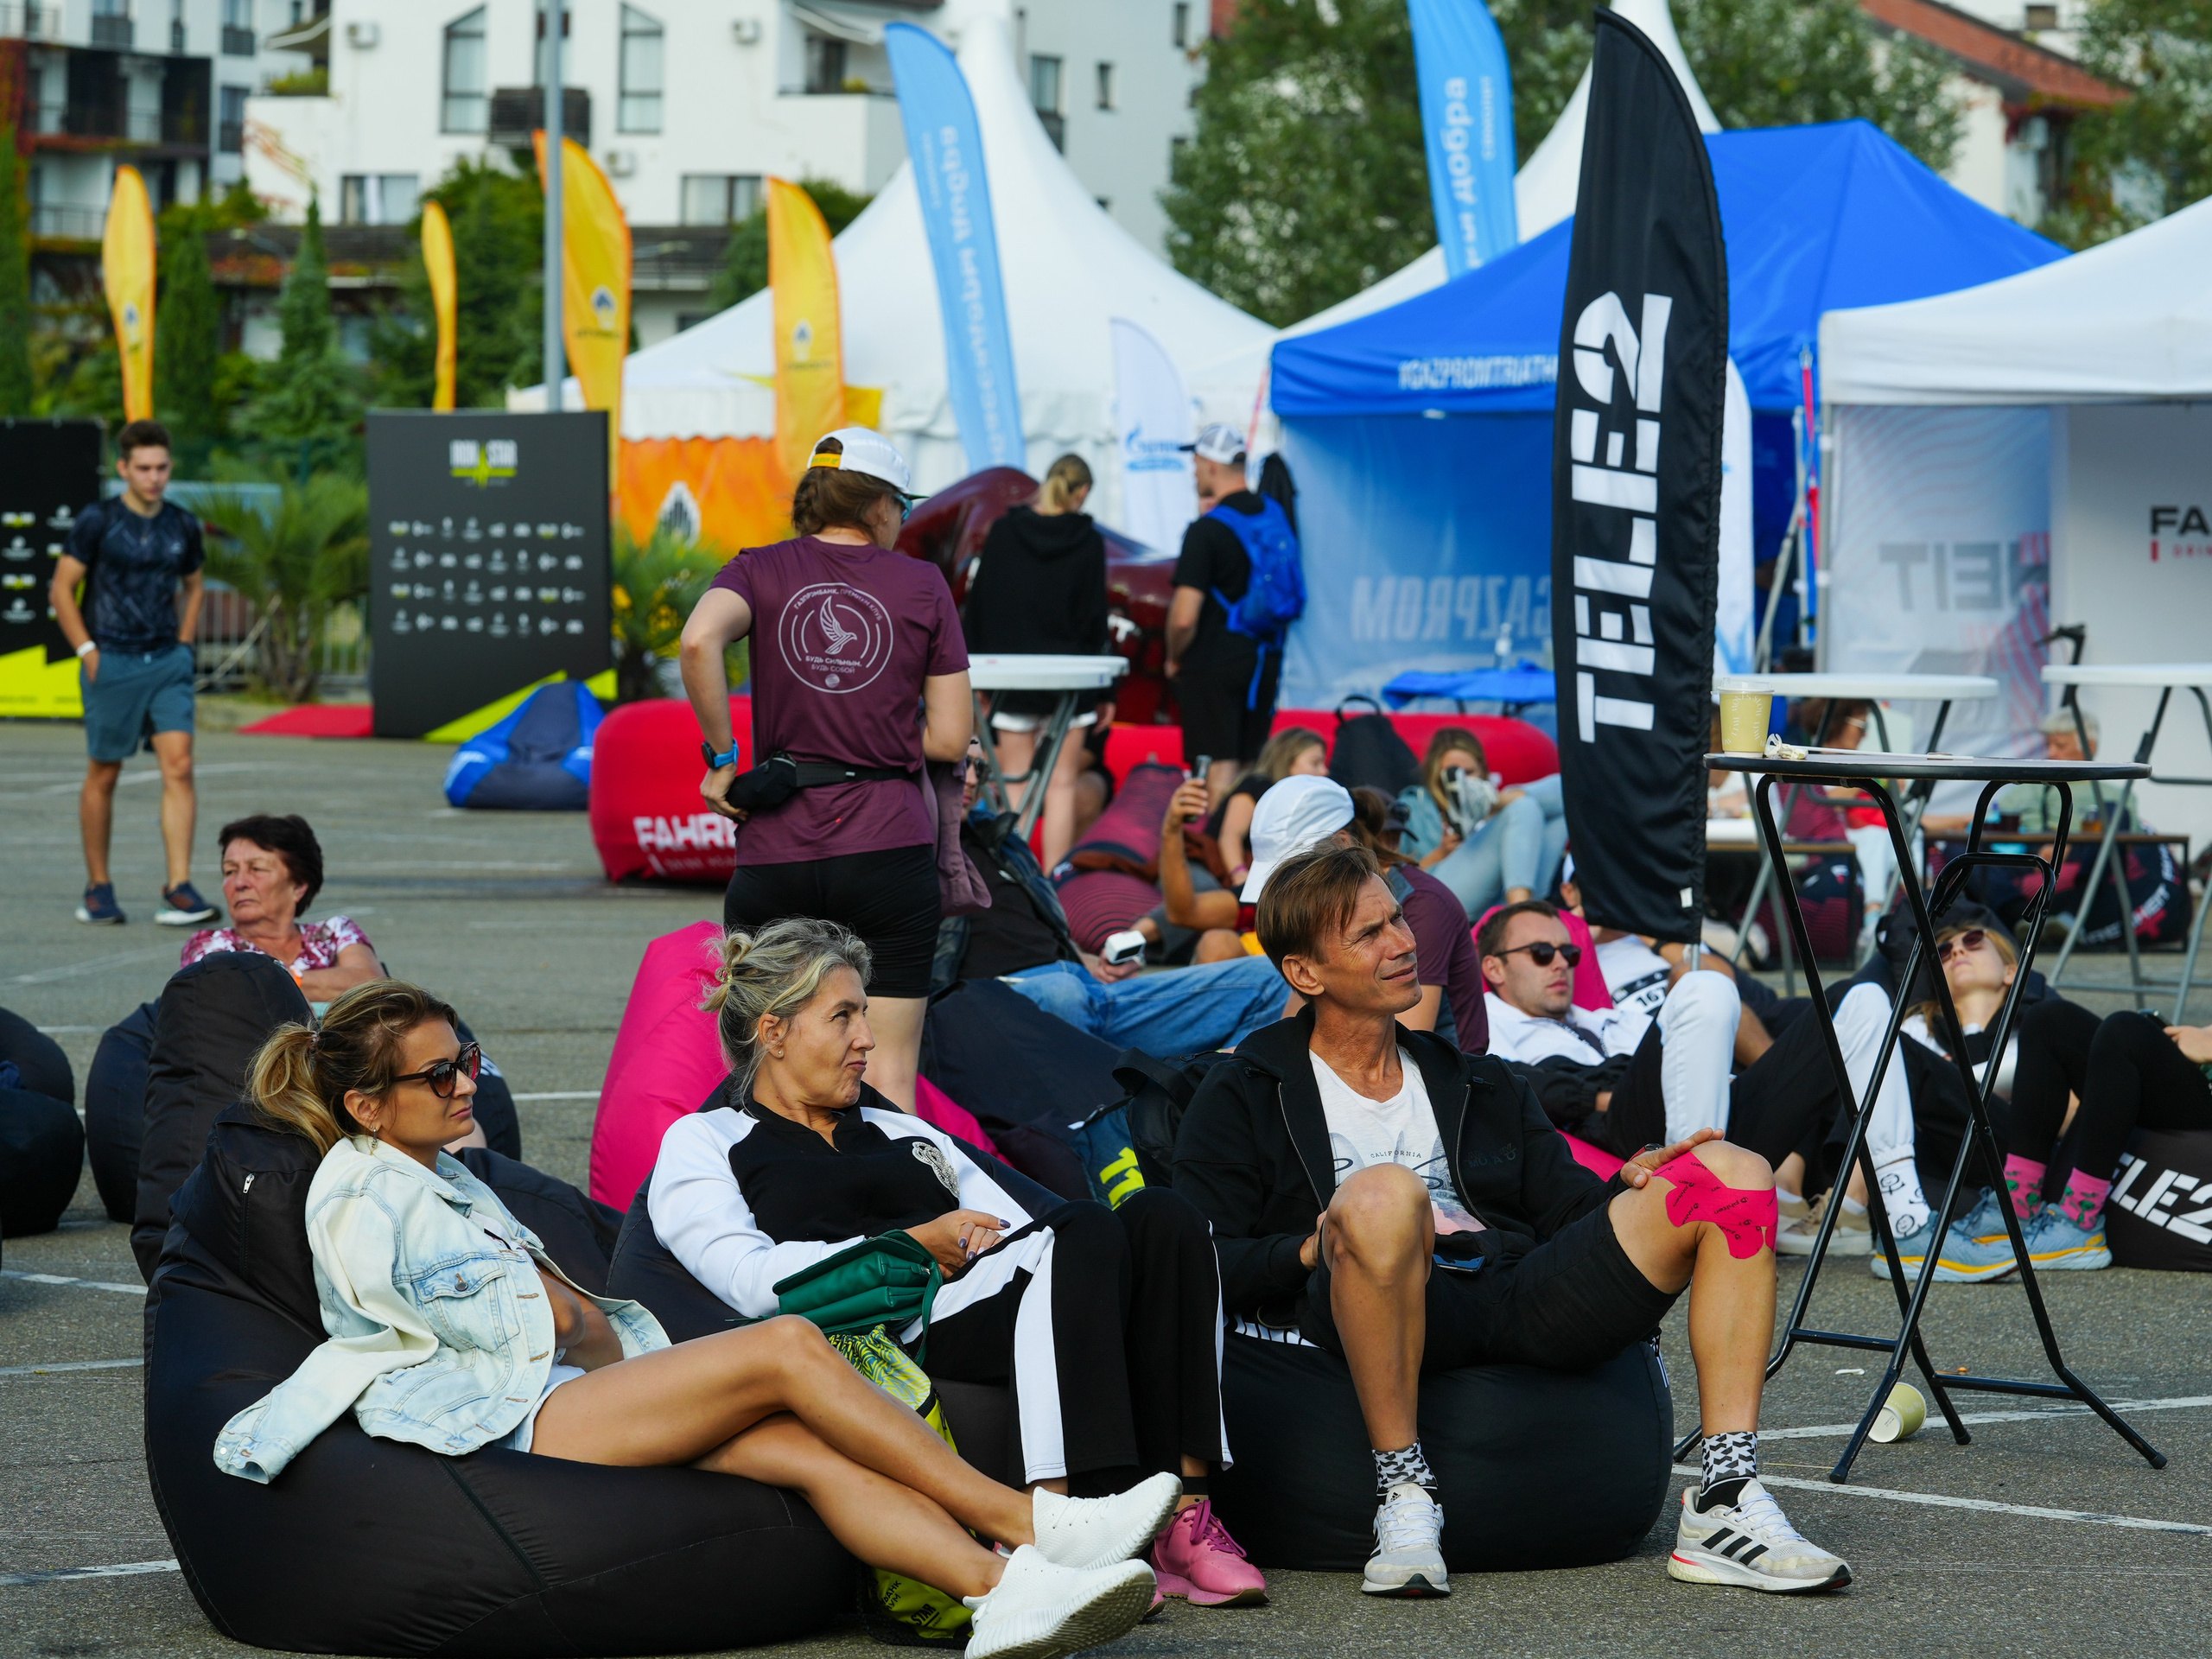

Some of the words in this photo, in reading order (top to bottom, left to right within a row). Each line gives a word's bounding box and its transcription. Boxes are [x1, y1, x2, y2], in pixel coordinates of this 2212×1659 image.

[1440, 76, 1478, 206] добра
[1571, 291, 1673, 743] TELE2
[805, 655, 823, 664] БУДЬ
[830, 664, 855, 674] СОБОЙ
[1370, 1149, 1421, 1159] CALIFORNIA
[1714, 1199, 1740, 1215] phiten
[910, 1603, 937, 1625] STAR
